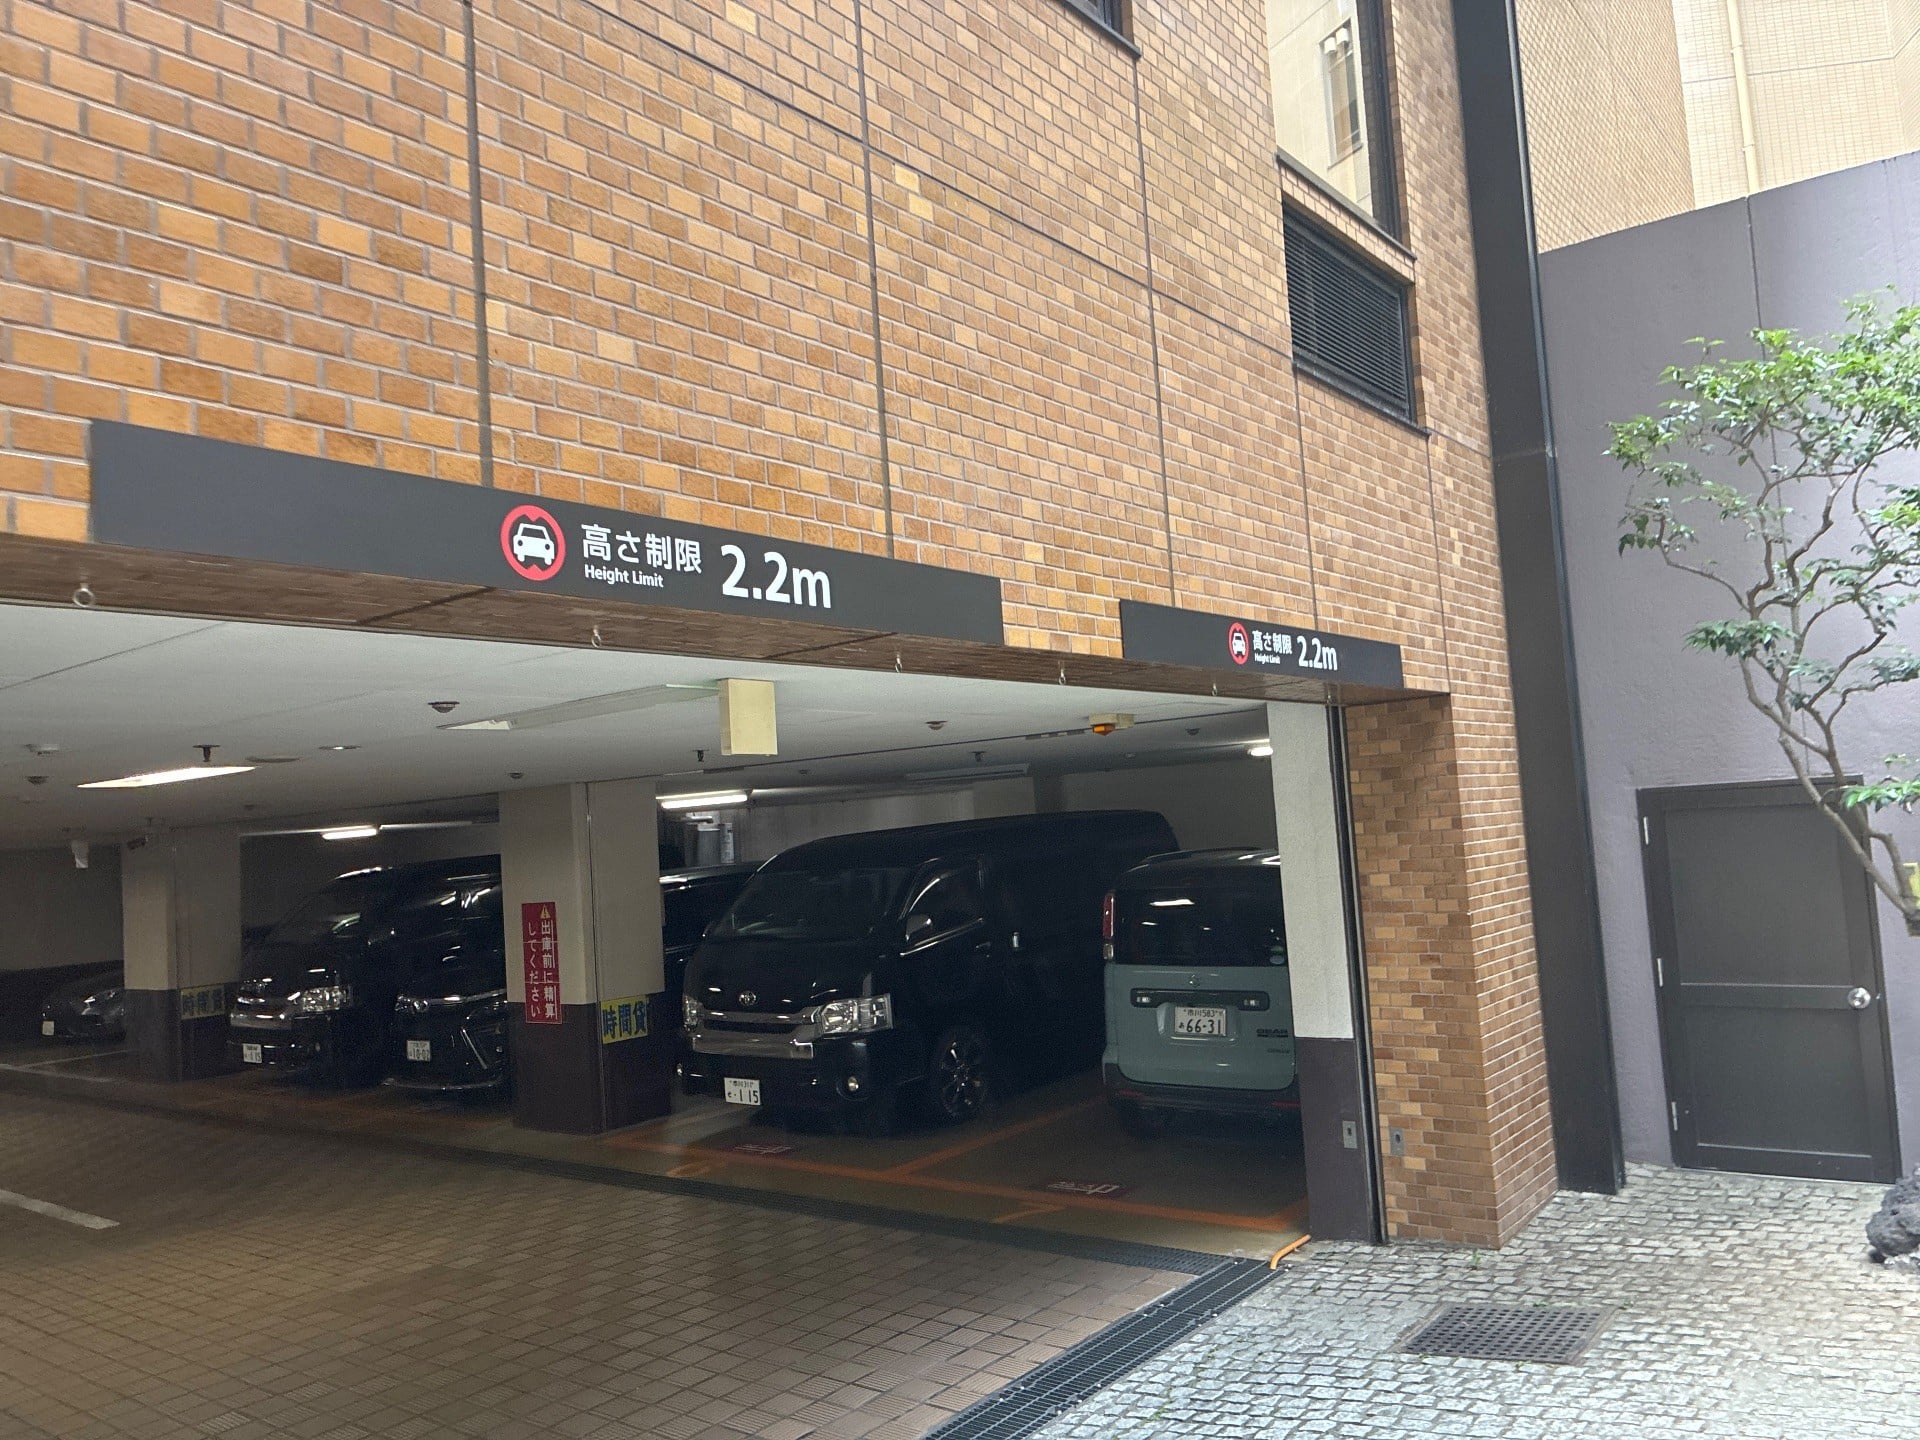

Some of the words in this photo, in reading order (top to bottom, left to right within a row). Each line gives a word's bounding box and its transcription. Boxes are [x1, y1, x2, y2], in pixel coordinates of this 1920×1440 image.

[581, 524, 702, 574] 高さ制限
[720, 544, 832, 609] 2.2m
[584, 564, 630, 585] Height
[632, 571, 664, 588] Limit
[1252, 630, 1293, 654] 高さ制限
[1297, 635, 1338, 671] 2.2m
[1254, 653, 1269, 664] Height
[528, 922, 541, 1018] してください
[541, 920, 556, 1018] 出庫前に精算
[602, 1001, 647, 1039] 時間貸
